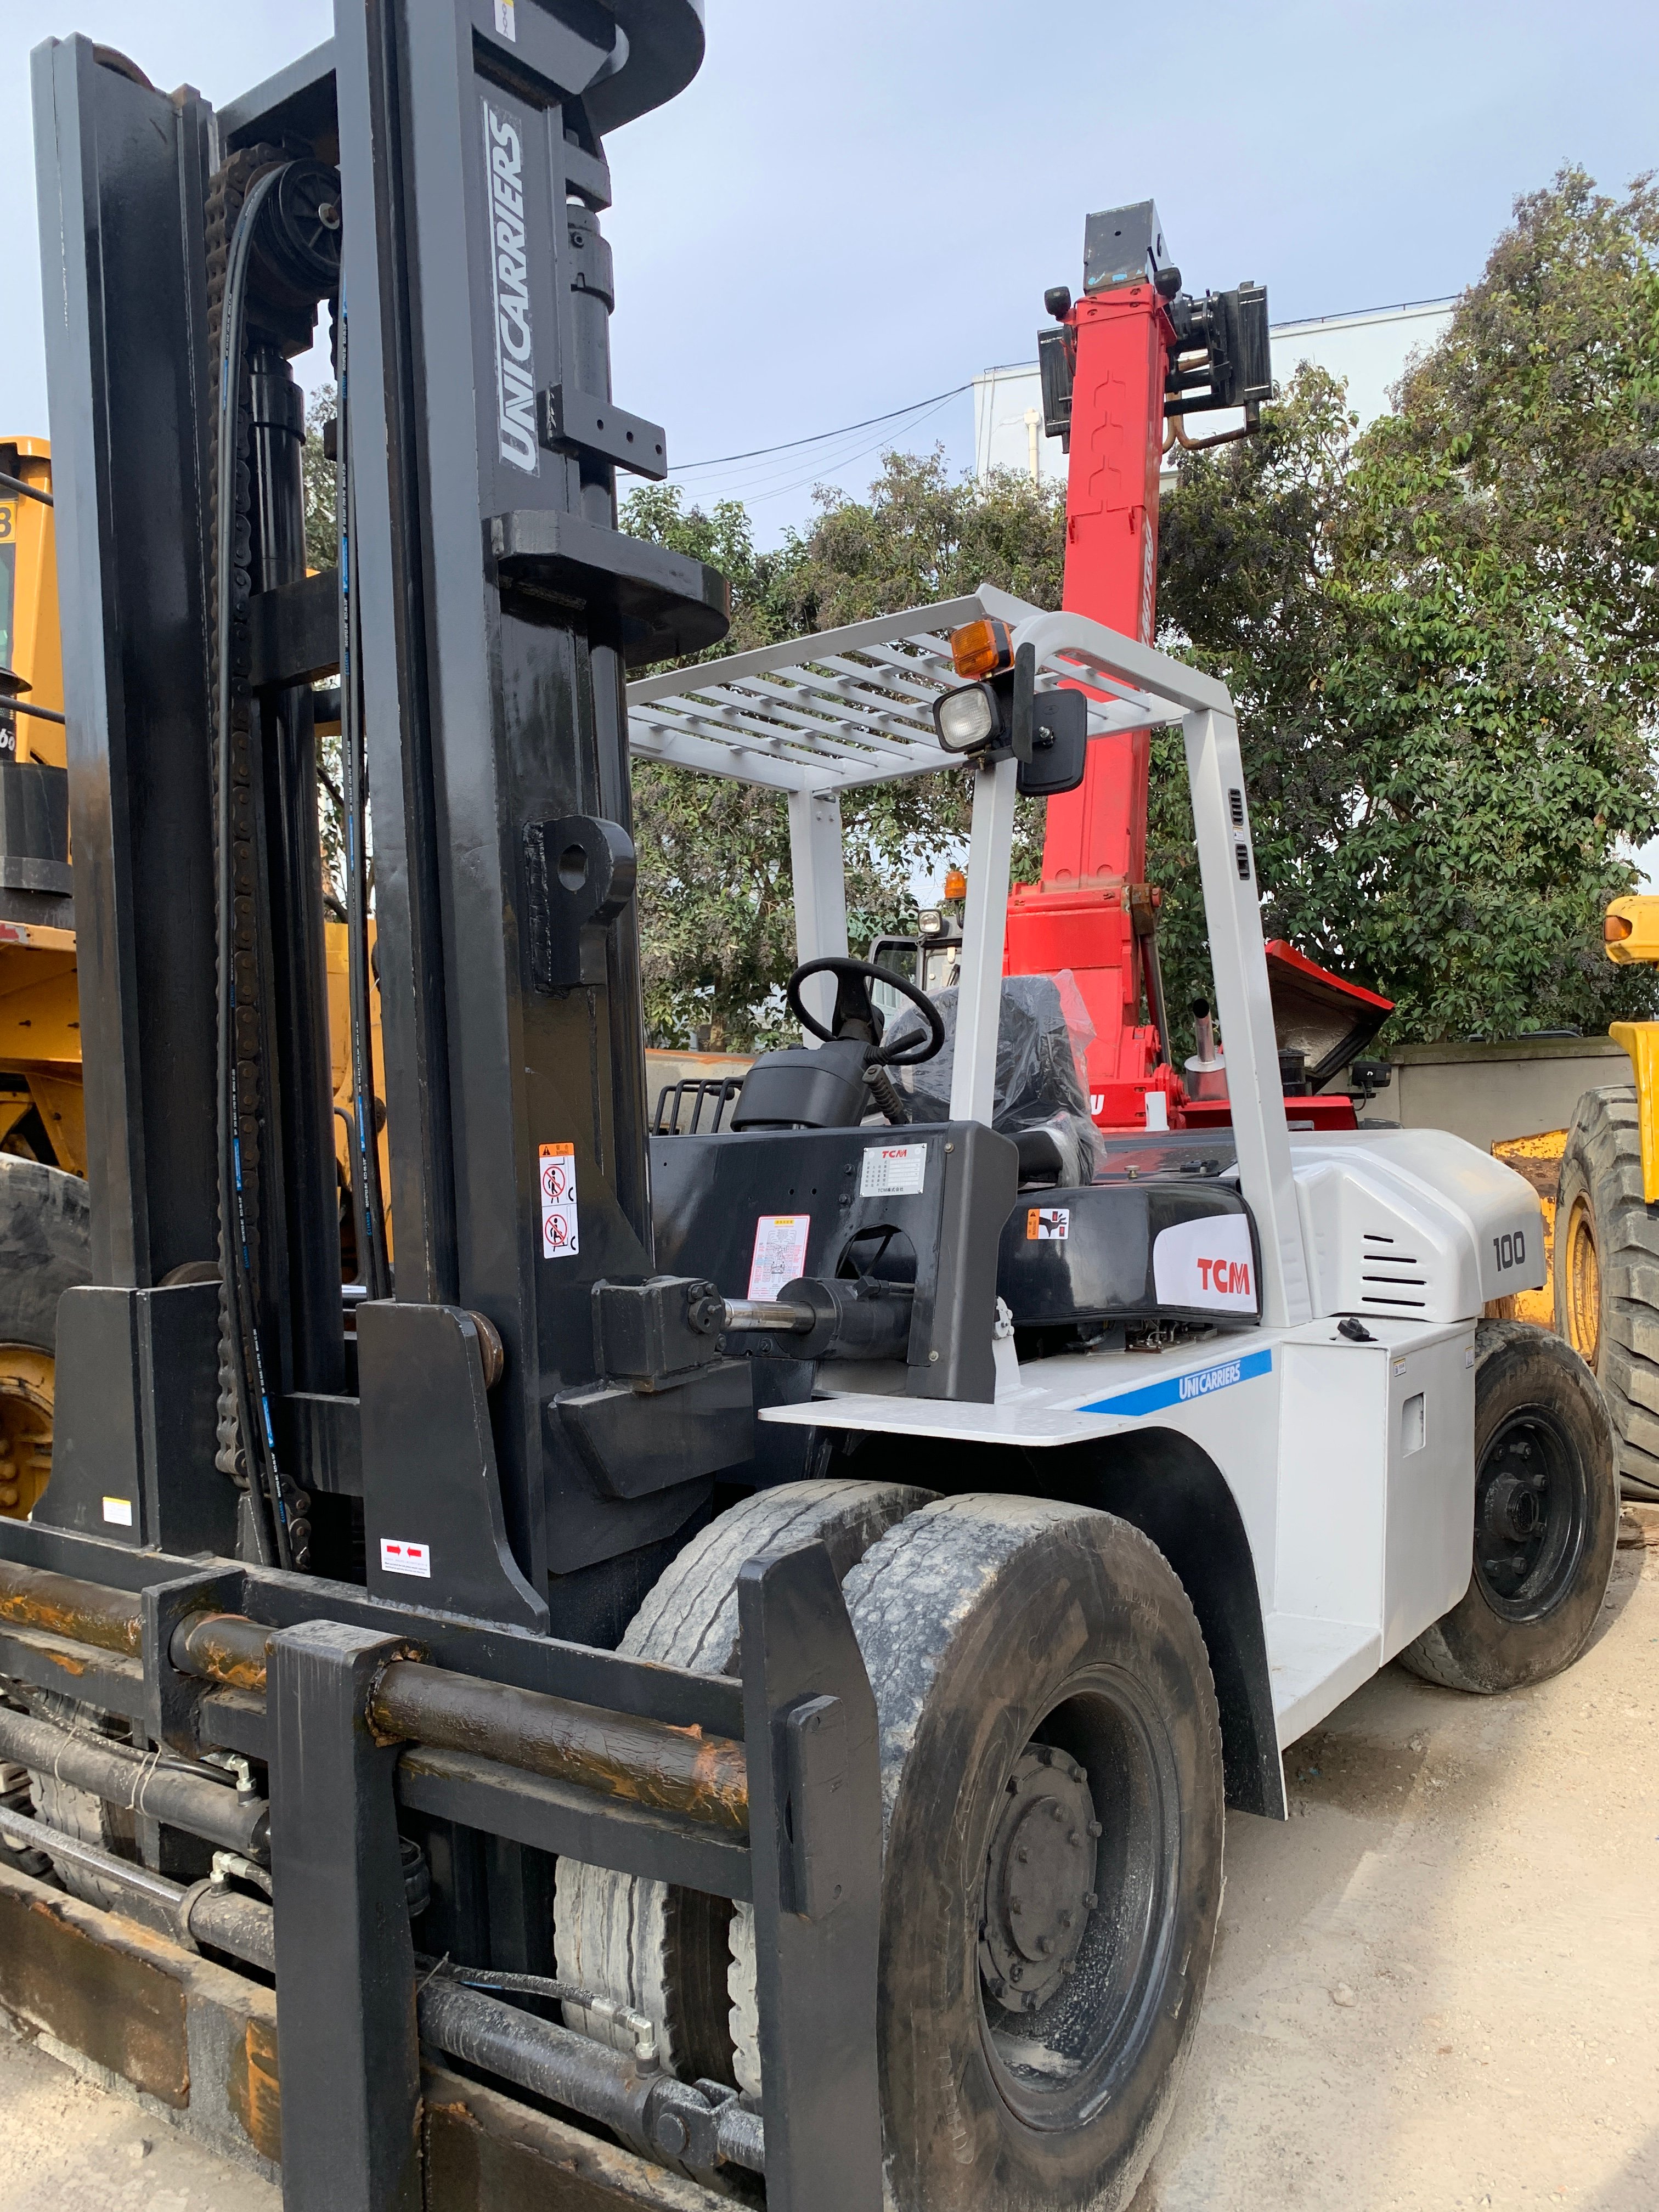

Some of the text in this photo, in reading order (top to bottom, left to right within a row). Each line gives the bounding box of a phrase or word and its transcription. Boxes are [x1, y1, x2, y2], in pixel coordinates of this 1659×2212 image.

[484, 101, 536, 471] UNICARRIERS
[882, 1149, 907, 1158] TCM
[1493, 1231, 1525, 1272] 100
[1197, 1258, 1250, 1295] TCM
[1180, 1360, 1241, 1399] UNICARRIERS
